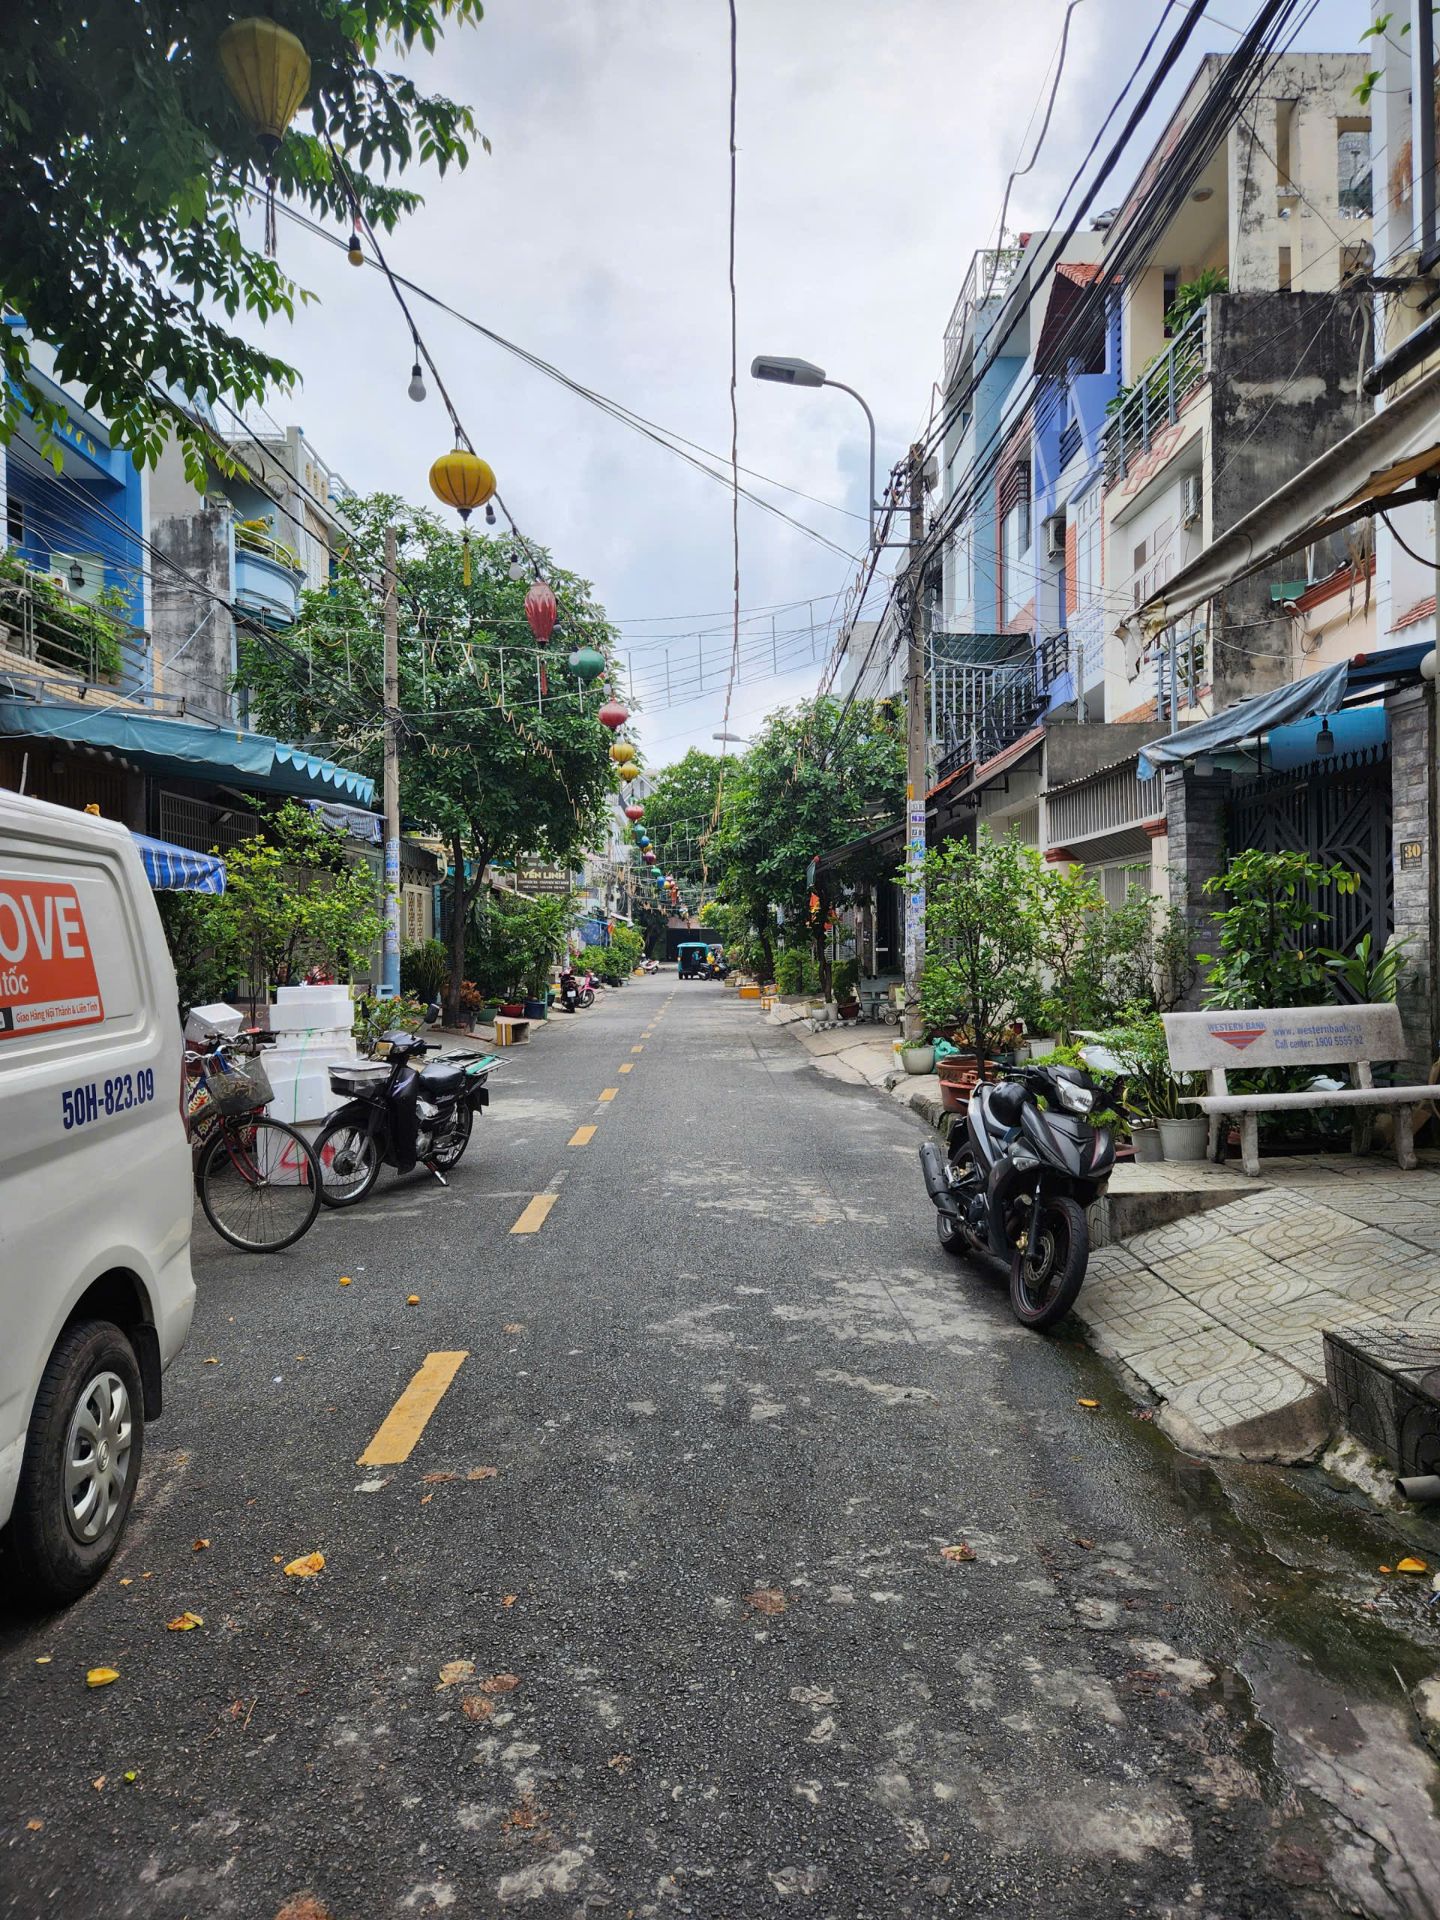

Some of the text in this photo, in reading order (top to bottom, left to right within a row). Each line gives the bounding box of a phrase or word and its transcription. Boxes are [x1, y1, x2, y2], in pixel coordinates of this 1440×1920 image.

[1404, 843, 1421, 859] 30
[522, 869, 565, 880] YẾN LINH
[16, 1011, 30, 1023] Giao
[1207, 1021, 1266, 1032] WESTERN BANK
[1275, 1039, 1288, 1049] Call
[1315, 1037, 1333, 1047] 1900
[62, 1068, 154, 1130] 50H-823.09
